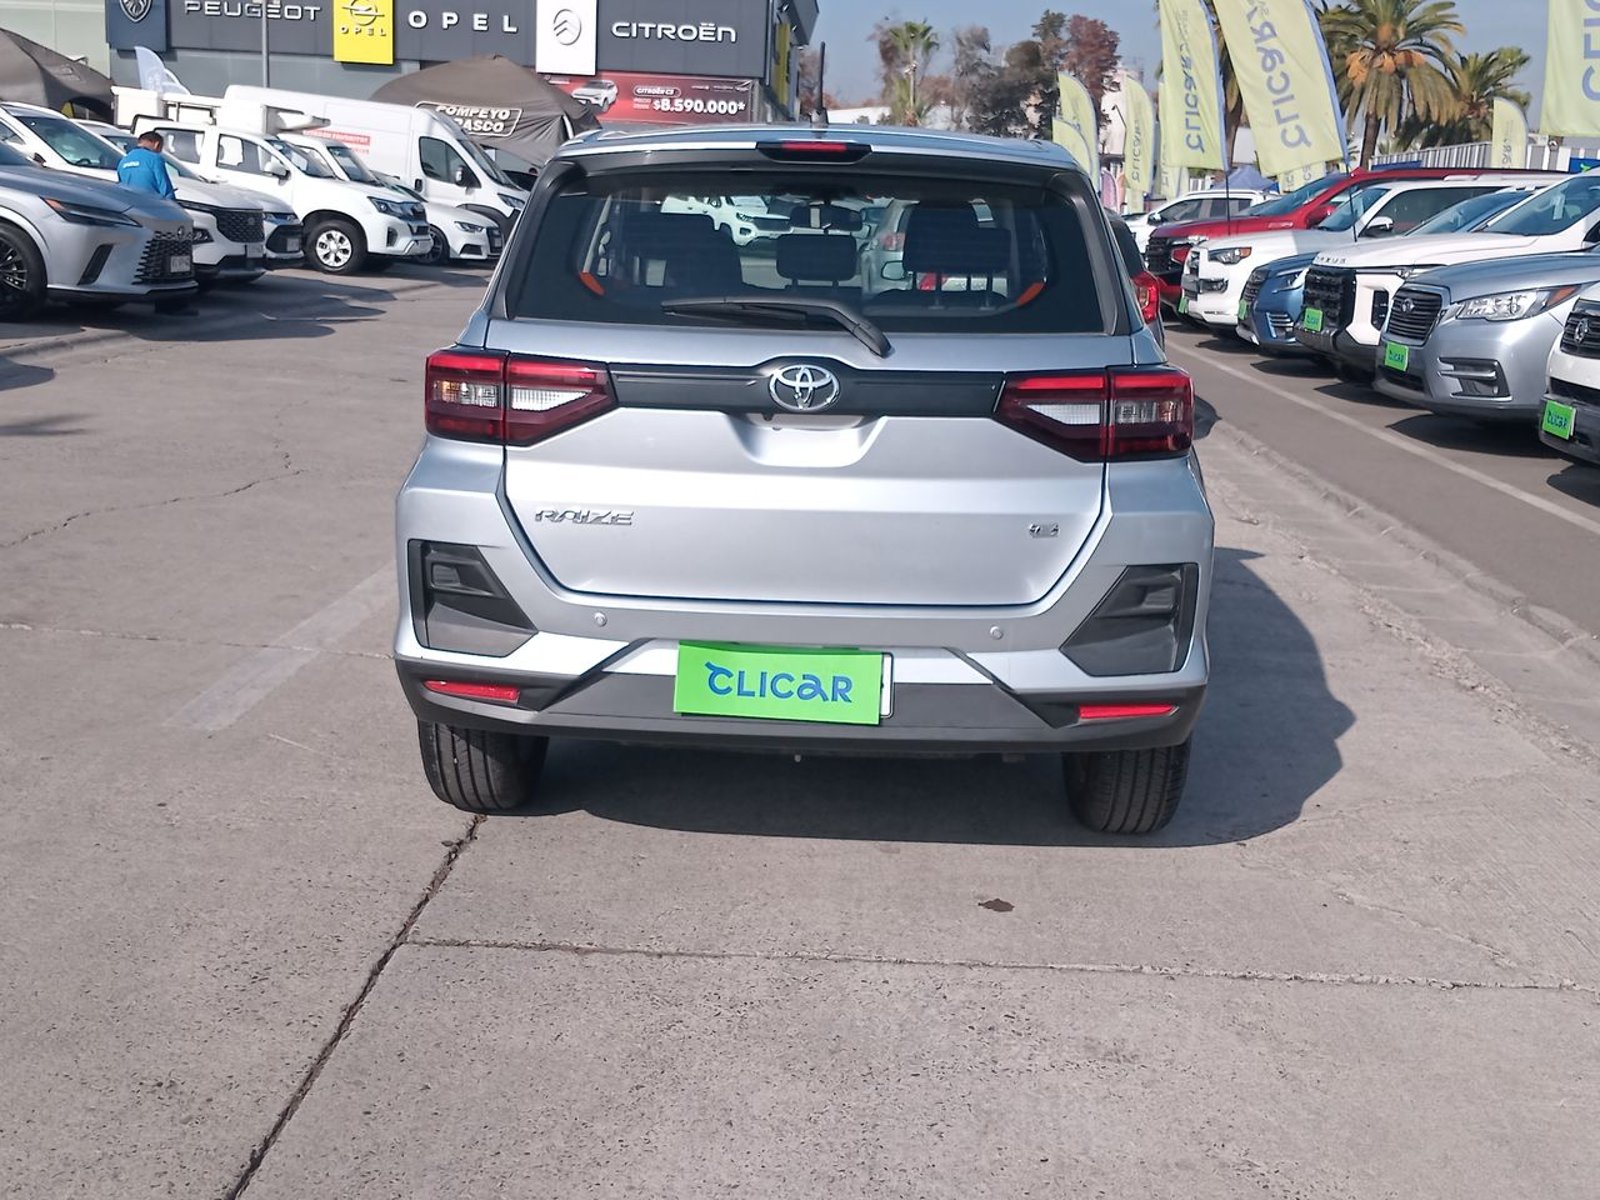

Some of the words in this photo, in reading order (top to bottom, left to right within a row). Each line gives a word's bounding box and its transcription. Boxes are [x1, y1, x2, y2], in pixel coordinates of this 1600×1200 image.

[185, 1, 321, 21] PEUGEOT
[408, 10, 517, 33] OPEL
[341, 26, 387, 36] OPEL
[535, 509, 635, 526] RAIZE
